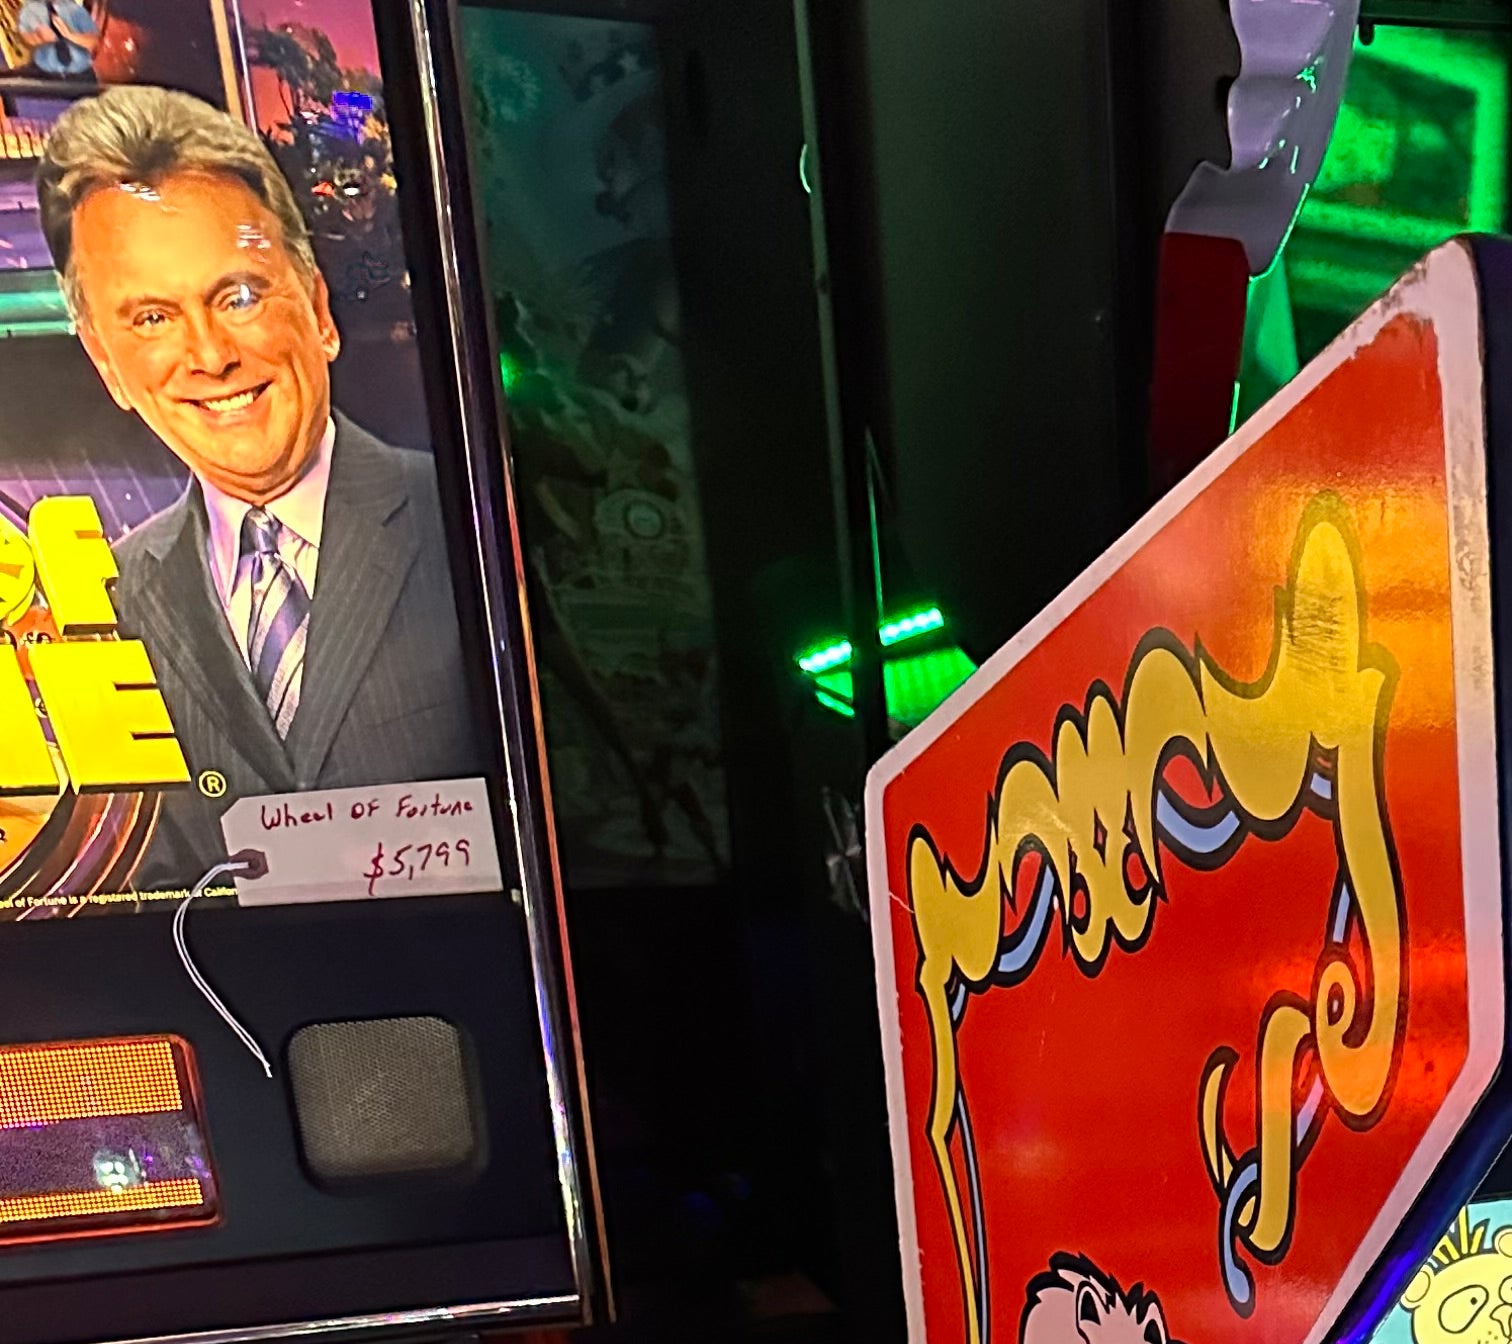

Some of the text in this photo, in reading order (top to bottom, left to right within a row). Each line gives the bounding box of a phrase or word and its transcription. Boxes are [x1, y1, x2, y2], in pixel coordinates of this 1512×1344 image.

[261, 802, 333, 830] Wheel
[395, 796, 473, 819] Fortune
[363, 839, 471, 896] $5,799
[27, 895, 67, 908] Fortune
[139, 888, 190, 902] trademark
